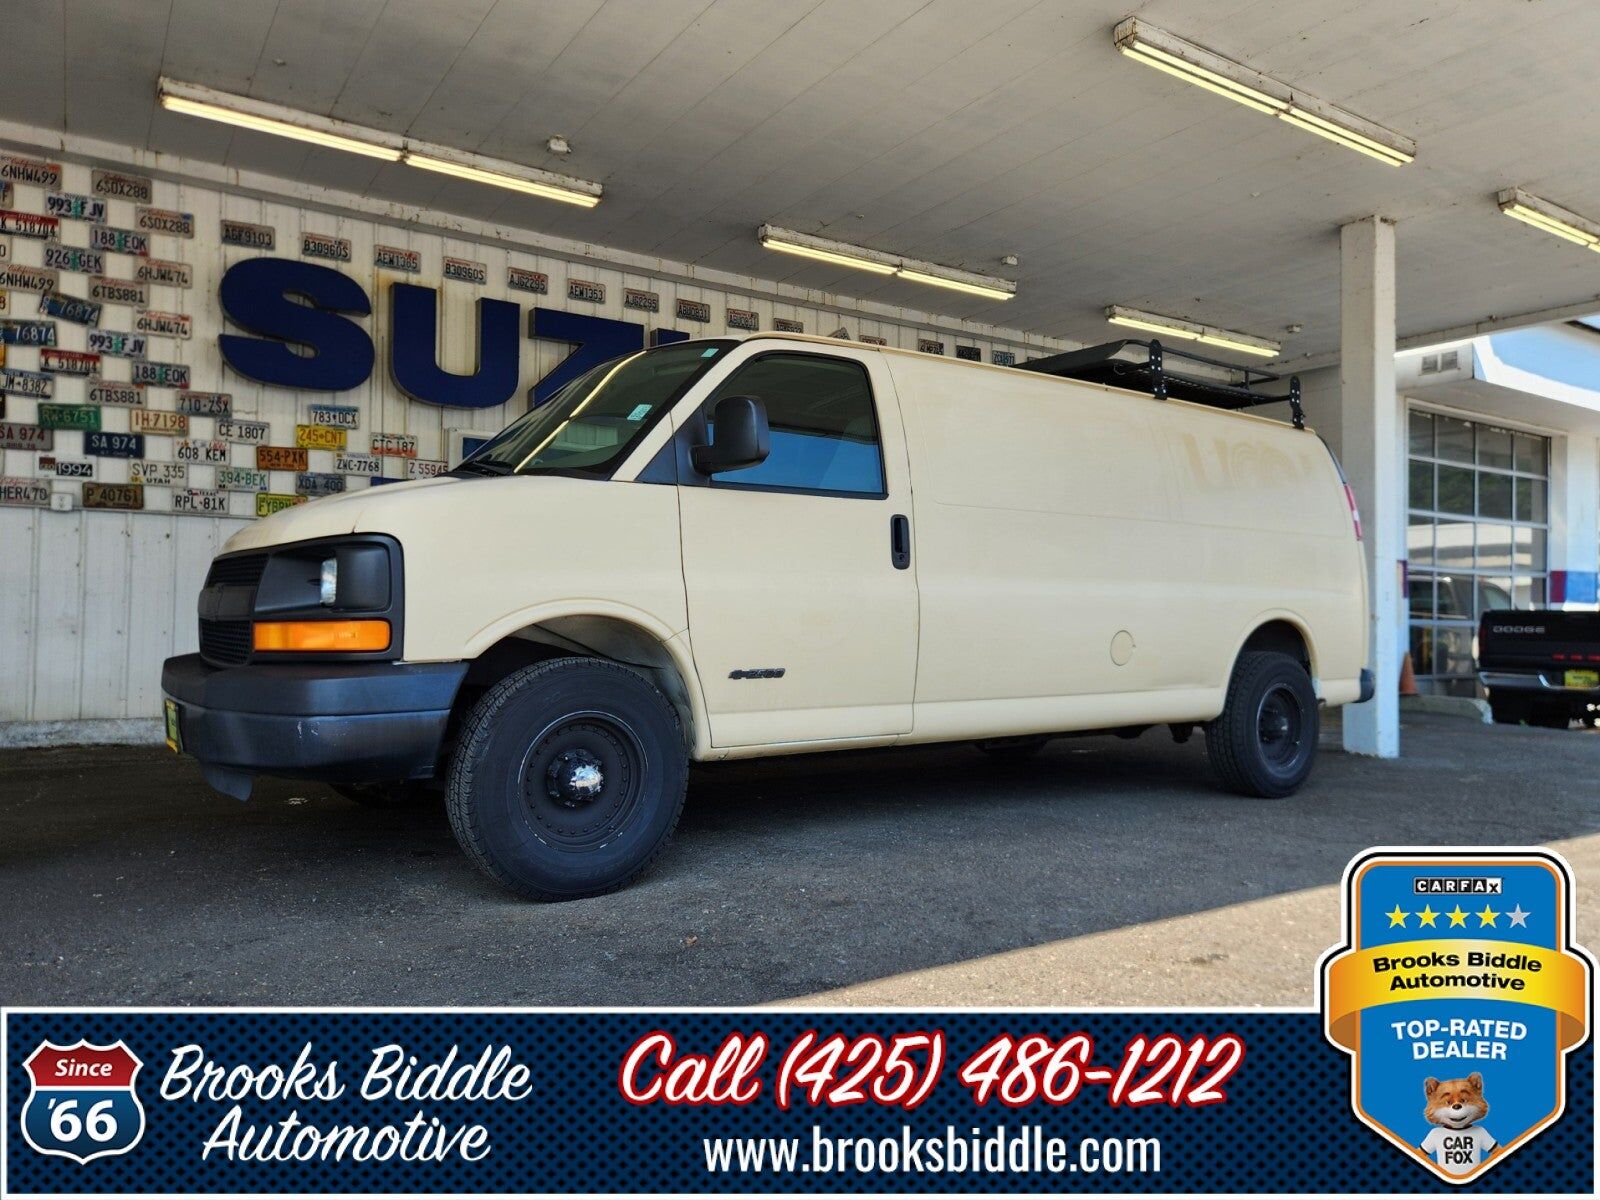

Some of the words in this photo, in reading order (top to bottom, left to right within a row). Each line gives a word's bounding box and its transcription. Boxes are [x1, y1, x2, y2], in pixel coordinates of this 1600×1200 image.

[1, 164, 57, 185] 6NHW499
[48, 196, 72, 213] 993
[94, 230, 116, 246] 188
[46, 248, 70, 265] 926
[79, 252, 102, 269] GEK
[0, 272, 54, 292] 6NHW499
[92, 285, 144, 304] 6TBS881
[137, 317, 187, 336] 6HJW474
[89, 334, 113, 349] 993
[135, 365, 156, 380] 188
[89, 388, 143, 405] 6TBS881
[313, 411, 331, 424] 783
[20, 427, 44, 441] 974
[219, 424, 233, 437] CE
[238, 426, 266, 440] 1807
[92, 435, 108, 448] SA
[112, 436, 136, 450] 974
[372, 438, 393, 452] CTC
[397, 440, 415, 453] 187
[178, 447, 199, 460] 608
[206, 449, 226, 462] KEM
[57, 462, 92, 477] 1994
[132, 463, 157, 476] SVP
[163, 465, 185, 479] 335
[409, 462, 415, 474] Z
[146, 477, 170, 485] UTAH
[86, 488, 95, 500] P
